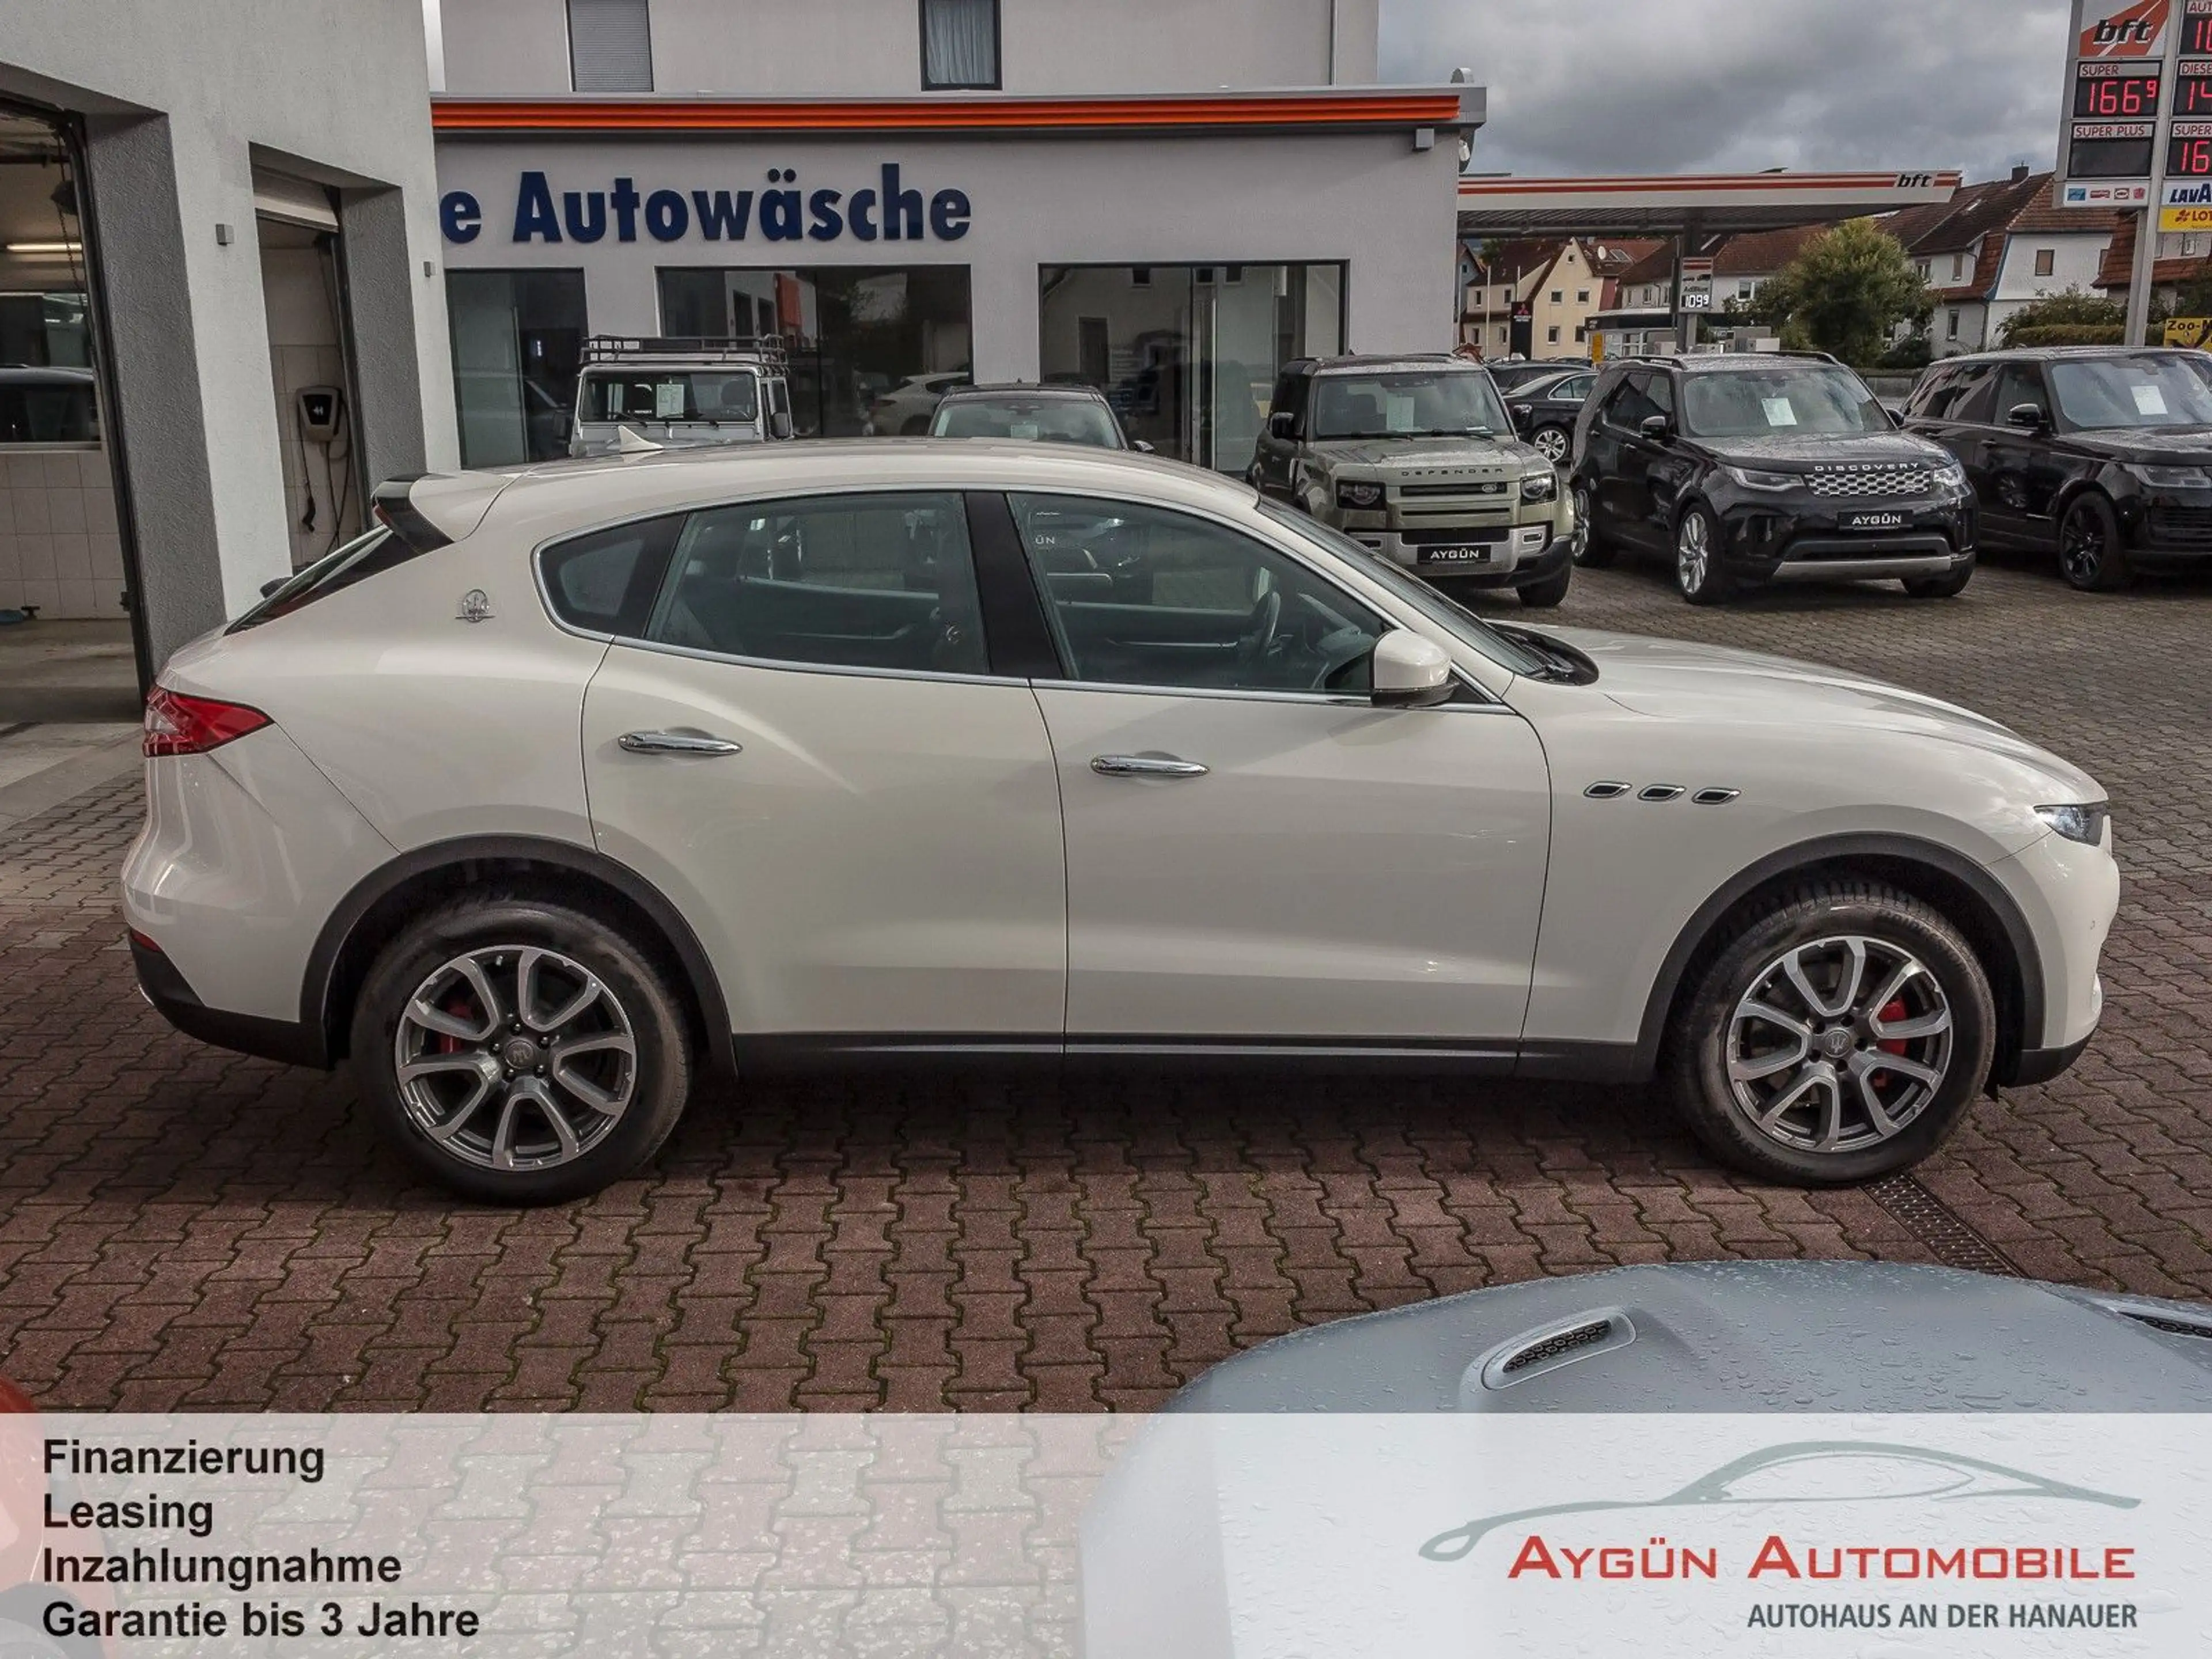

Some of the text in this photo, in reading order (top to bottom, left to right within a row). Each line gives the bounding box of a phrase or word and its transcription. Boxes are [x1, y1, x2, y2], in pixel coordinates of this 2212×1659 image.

[2093, 19, 2153, 44] bft
[2082, 65, 2119, 76] SUPER
[2076, 125, 2145, 137] SUPER PLUS
[2175, 125, 2211, 135] SUPER
[2181, 141, 2210, 172] 16
[1897, 174, 1932, 187] bft
[440, 163, 972, 244] e Autowäsche
[1815, 463, 1919, 471] DISCOVERY
[1851, 513, 1902, 525] AYGÜN
[1430, 548, 1479, 559] AYGÜN
